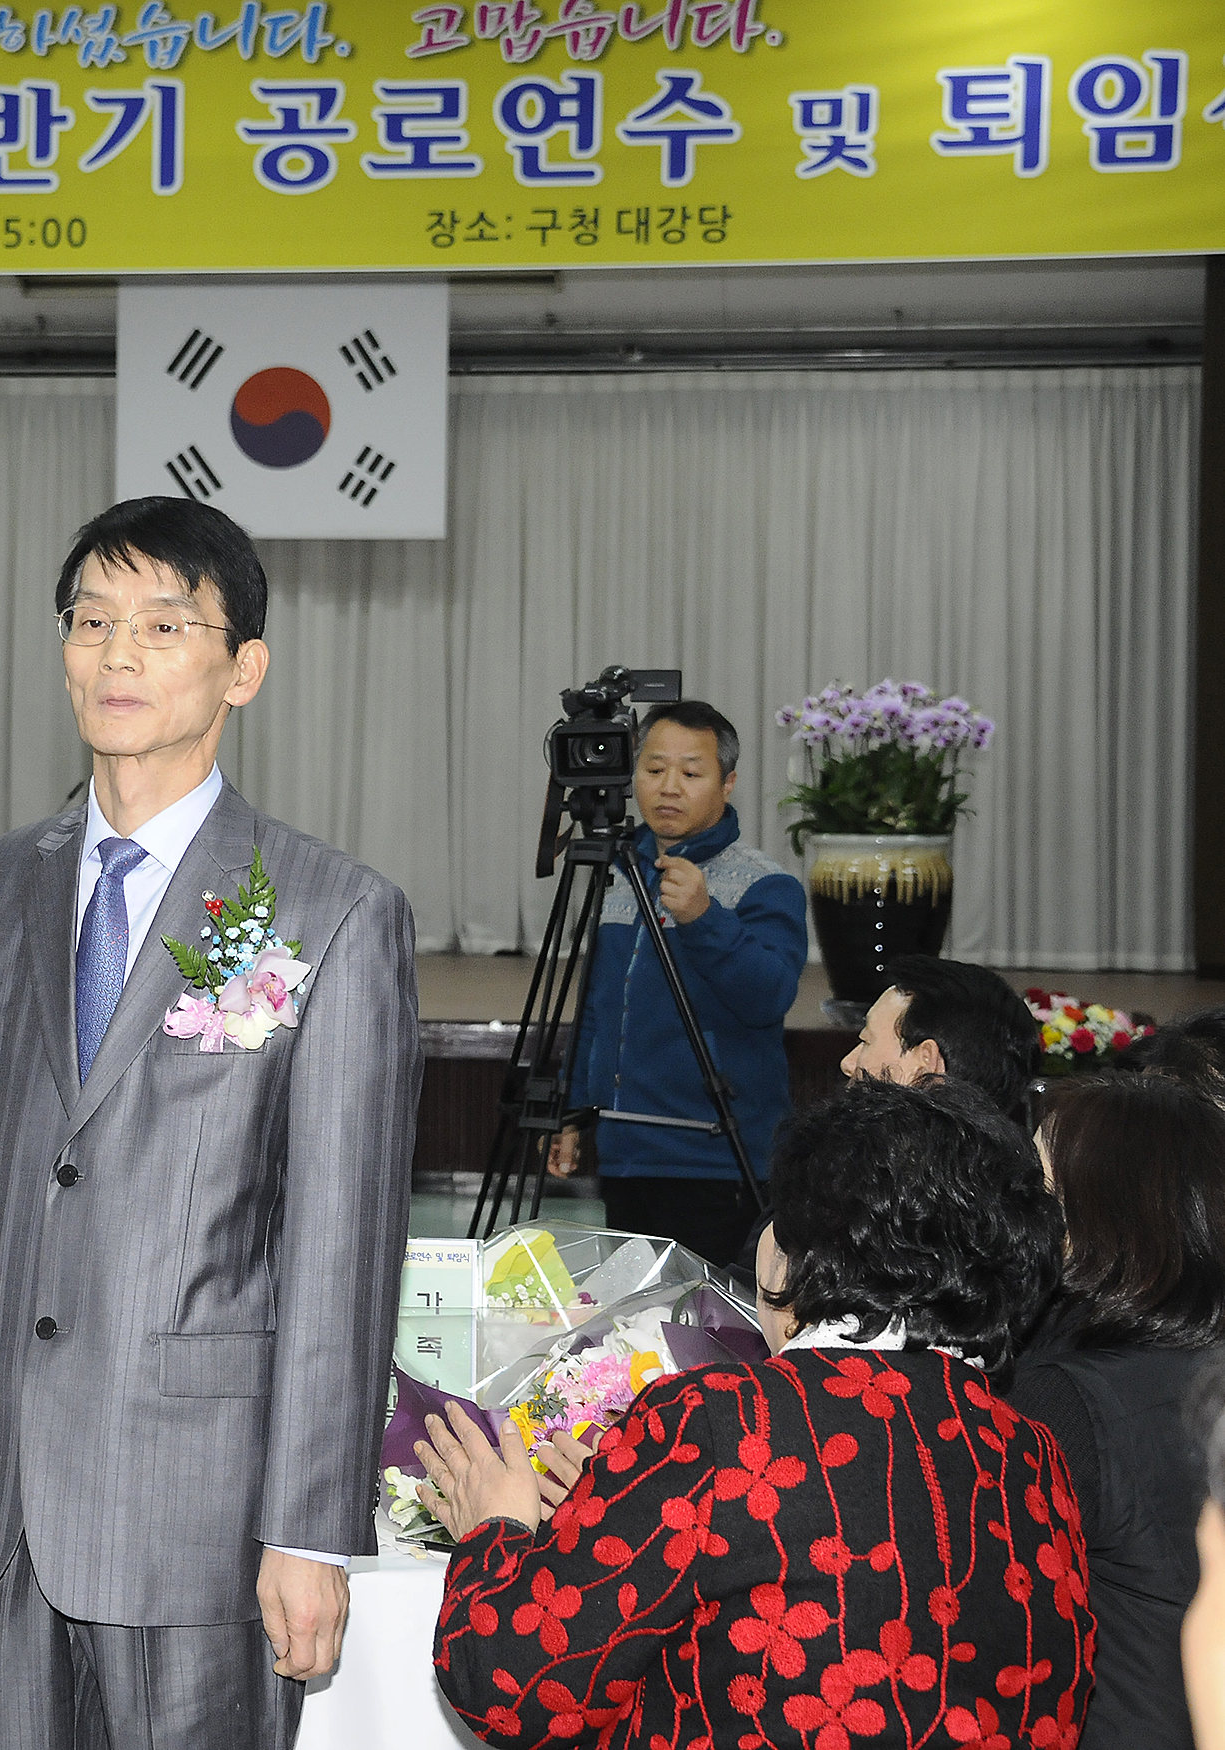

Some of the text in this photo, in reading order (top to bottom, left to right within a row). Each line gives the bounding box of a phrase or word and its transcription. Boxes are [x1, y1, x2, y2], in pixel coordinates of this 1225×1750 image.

[405, 0, 783, 62] 고맙습니다.
[236, 70, 741, 193] 공로연수
[789, 85, 878, 178] 및
[931, 49, 1225, 178] 퇴임
[426, 205, 732, 248] 장소: 구청 대강당
